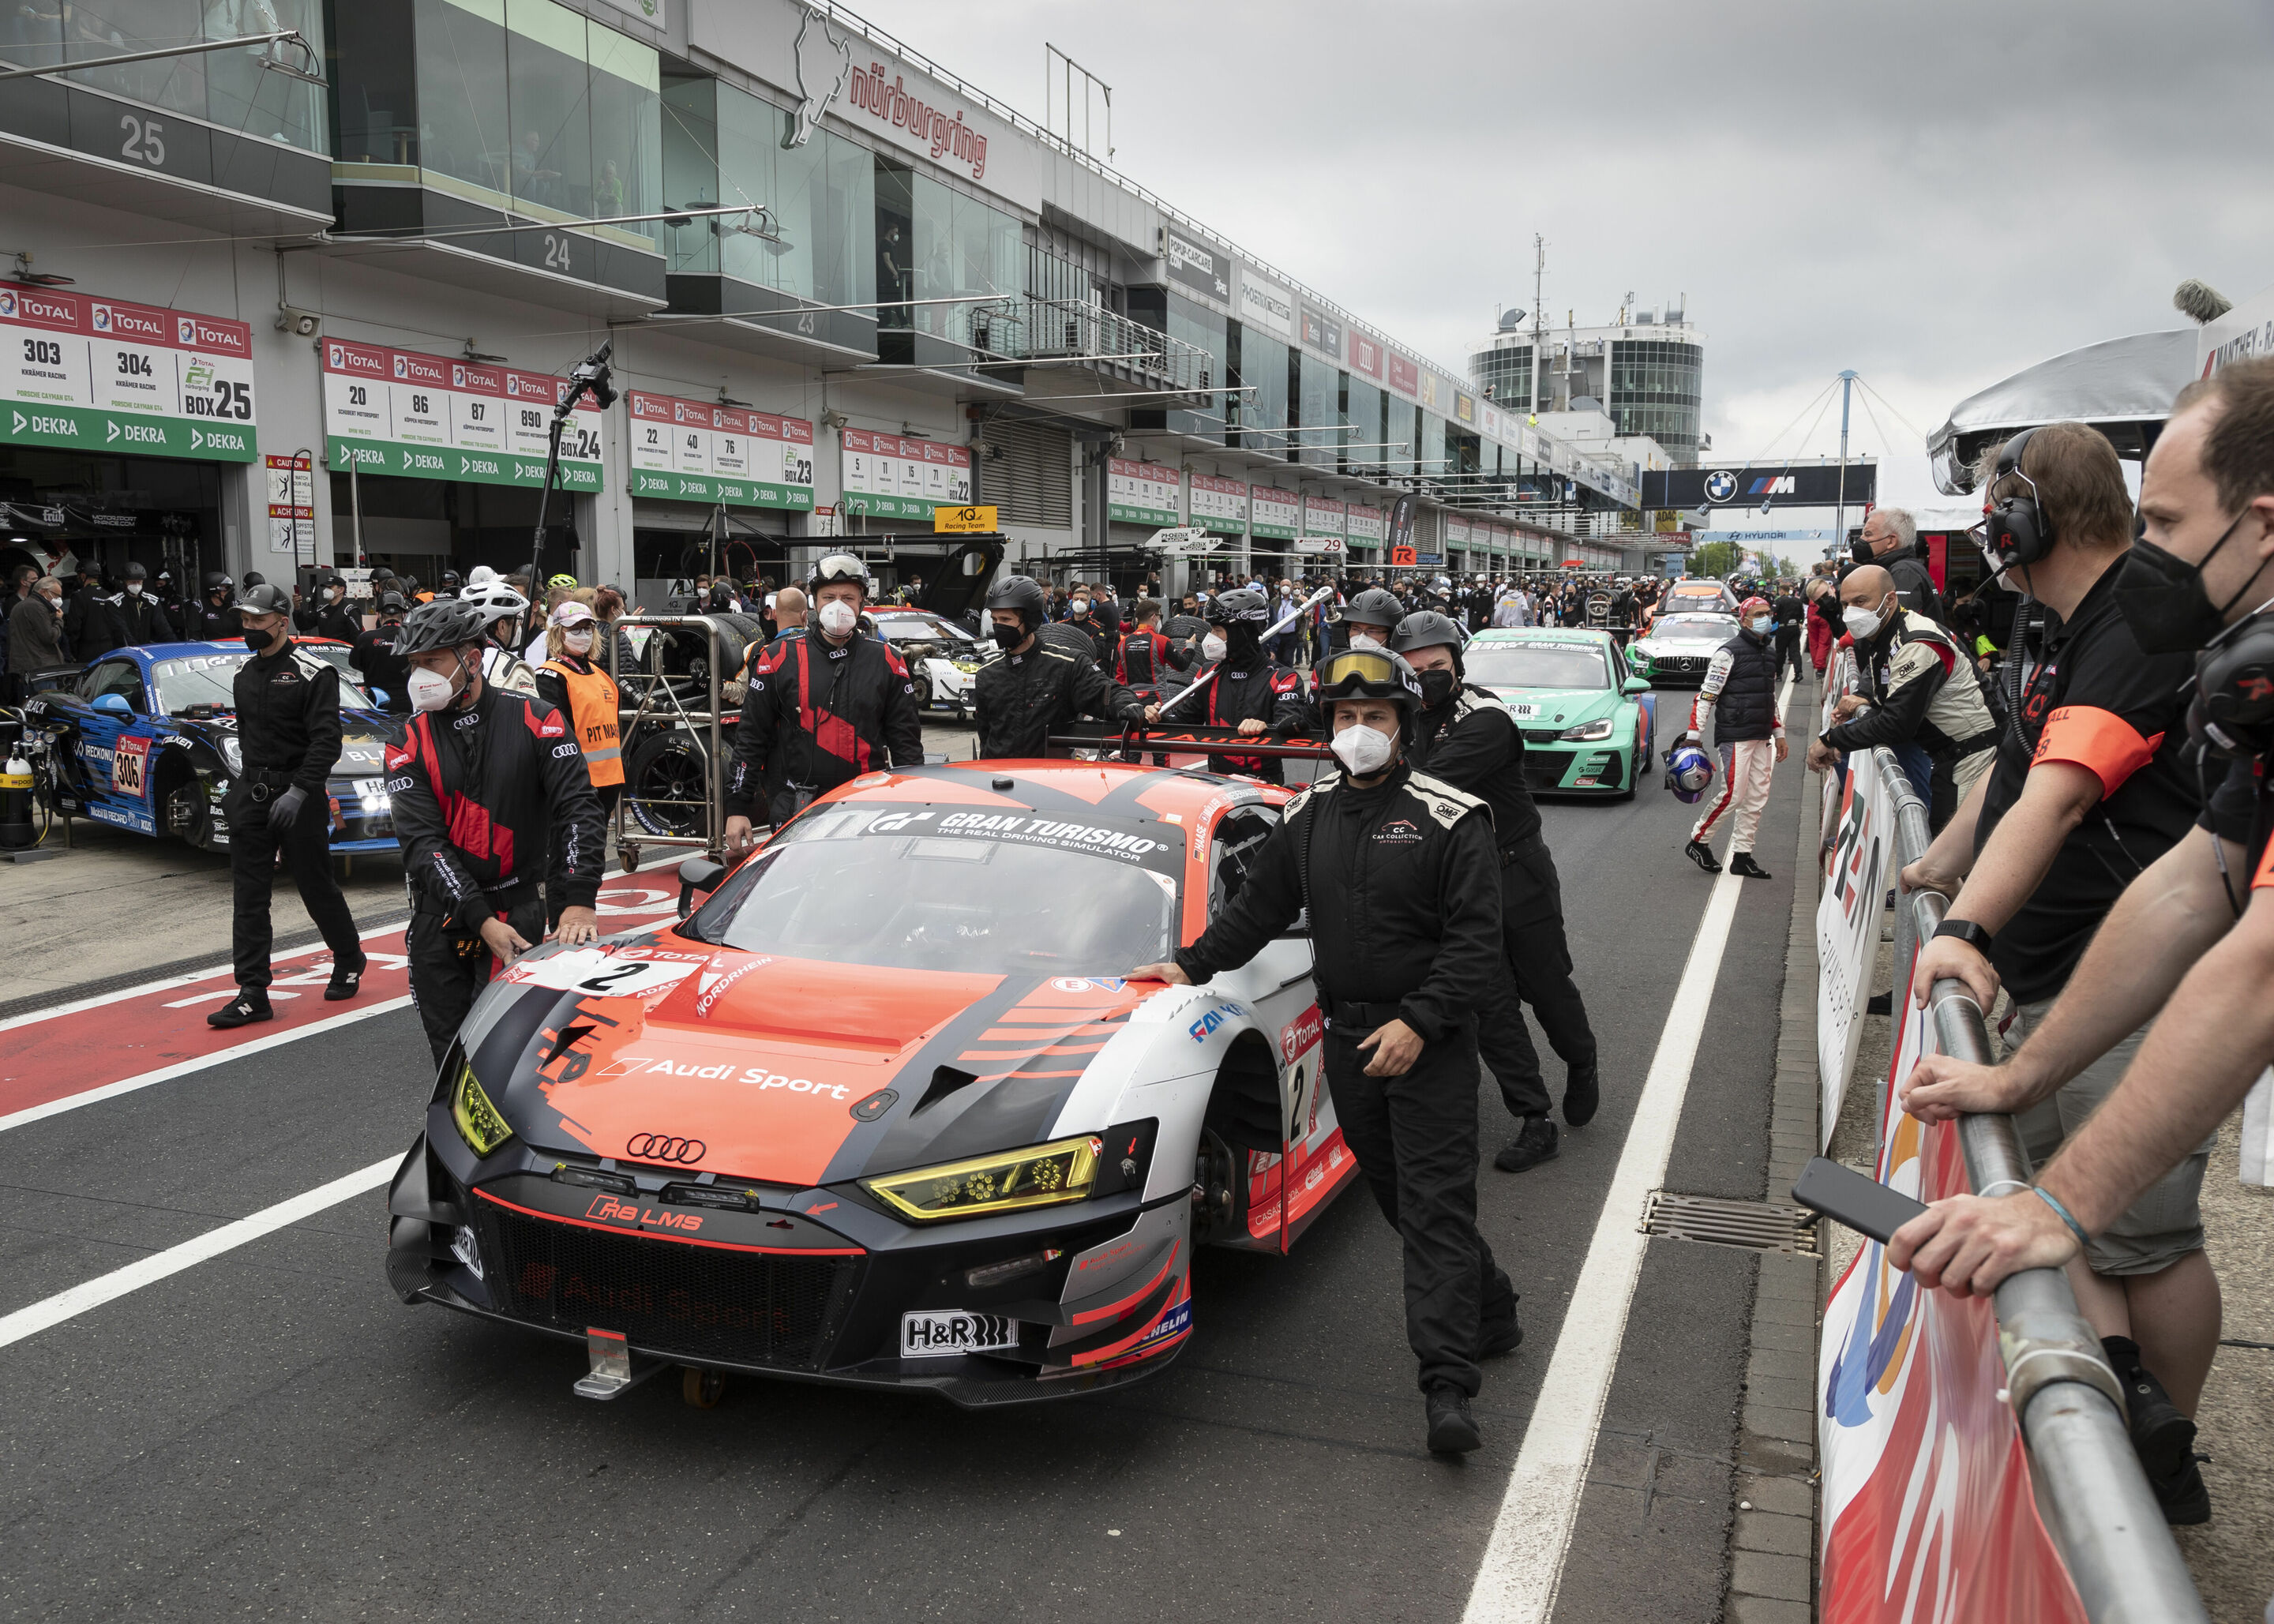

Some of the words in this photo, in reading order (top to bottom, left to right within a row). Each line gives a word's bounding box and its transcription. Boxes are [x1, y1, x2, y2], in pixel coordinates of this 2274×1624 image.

[851, 62, 987, 179] nürburgring
[120, 115, 165, 165] 25
[545, 234, 570, 271] 24
[1171, 238, 1211, 271] POPUP-CARCARE
[21, 298, 74, 321] TOTAL
[114, 313, 162, 334] TOTAL
[797, 311, 814, 335] 23
[197, 327, 242, 346] TOTAL
[24, 339, 61, 366] 303
[2216, 326, 2260, 371] MANTHEY
[118, 352, 152, 377] 304
[346, 351, 382, 369] TOTAL
[21, 368, 47, 378] KKRÄMER
[47, 371, 66, 381] RACING
[409, 362, 442, 379] TOTAL
[467, 370, 497, 388] TOTAL
[116, 380, 138, 388] KKRÄMER
[520, 379, 548, 396] TOTAL
[17, 390, 39, 399] PORSCHE
[41, 392, 63, 401] CAYMAN
[186, 396, 216, 417] BOX
[215, 381, 251, 420] 25
[350, 385, 366, 405] 20
[413, 395, 428, 414] 86
[471, 403, 485, 421] 87
[644, 401, 667, 415] TOTAL
[357, 411, 380, 419] MOTORSPORT
[521, 410, 541, 428] 890
[685, 408, 706, 421] TOTAL
[722, 415, 742, 427] TOTAL
[32, 416, 77, 436] DEKRA
[757, 421, 776, 433] TOTAL
[790, 426, 809, 437] TOTAL
[126, 426, 167, 444] DEKRA
[208, 433, 245, 450] DEKRA
[647, 429, 657, 444] 22
[687, 434, 697, 448] 40
[853, 437, 869, 446] TOTAL
[561, 441, 578, 458] BOX
[578, 429, 601, 459] 24
[726, 440, 734, 454] 76
[880, 441, 895, 450] TOTAL
[906, 444, 920, 454] TOTAL
[930, 449, 944, 458] TOTAL
[416, 455, 445, 471] DEKRA
[472, 459, 499, 474] DEKRA
[855, 459, 860, 471] 5
[573, 470, 596, 483] DEKRA
[785, 470, 797, 482] BOX
[797, 460, 812, 484] 23
[908, 466, 914, 478] 15
[1710, 472, 1734, 482] BMW
[648, 478, 669, 491] DEKRA
[689, 482, 707, 494] DEKRA
[725, 486, 743, 497] DEKRA
[949, 489, 958, 501] BOX
[958, 481, 969, 501] 22
[1767, 476, 1795, 493] M
[760, 489, 777, 501] DEKRA
[793, 493, 809, 504] DEKRA
[881, 501, 895, 512] DEKRA
[908, 504, 920, 514] DEKRA
[1656, 511, 1676, 523] ADAC
[1324, 539, 1341, 551] 29
[1899, 662, 1916, 676] OMP
[586, 726, 599, 743] PIT
[1166, 733, 1272, 746] Audi
[127, 741, 143, 752] TOTAL
[117, 752, 139, 789] 306
[1286, 797, 1302, 812] OMP
[1436, 804, 1458, 818] OMP
[940, 812, 1022, 833] GRAN
[936, 827, 959, 835] THE
[961, 829, 999, 840] REAL
[1000, 832, 1057, 846] DRIVING
[1060, 840, 1141, 862] SIMULATOR
[1194, 823, 1206, 852] HAASE
[433, 861, 454, 888] customer
[439, 858, 452, 872] Audi
[448, 872, 461, 889] Sport
[653, 951, 724, 968] TOTAL
[577, 962, 650, 992] 2
[1066, 980, 1082, 989] E
[696, 957, 772, 1016] NORDRHEIN
[1296, 1018, 1320, 1048] TOTAL
[645, 1060, 736, 1081] Audi
[739, 1067, 850, 1103] Sport
[1290, 1063, 1304, 1143] 2
[602, 1202, 638, 1221] R8
[640, 1210, 704, 1232] LMS
[1255, 1202, 1277, 1225] CASA
[1090, 1253, 1109, 1264] Audi
[1109, 1242, 1131, 1256] Sport
[907, 1318, 974, 1350] H&R
